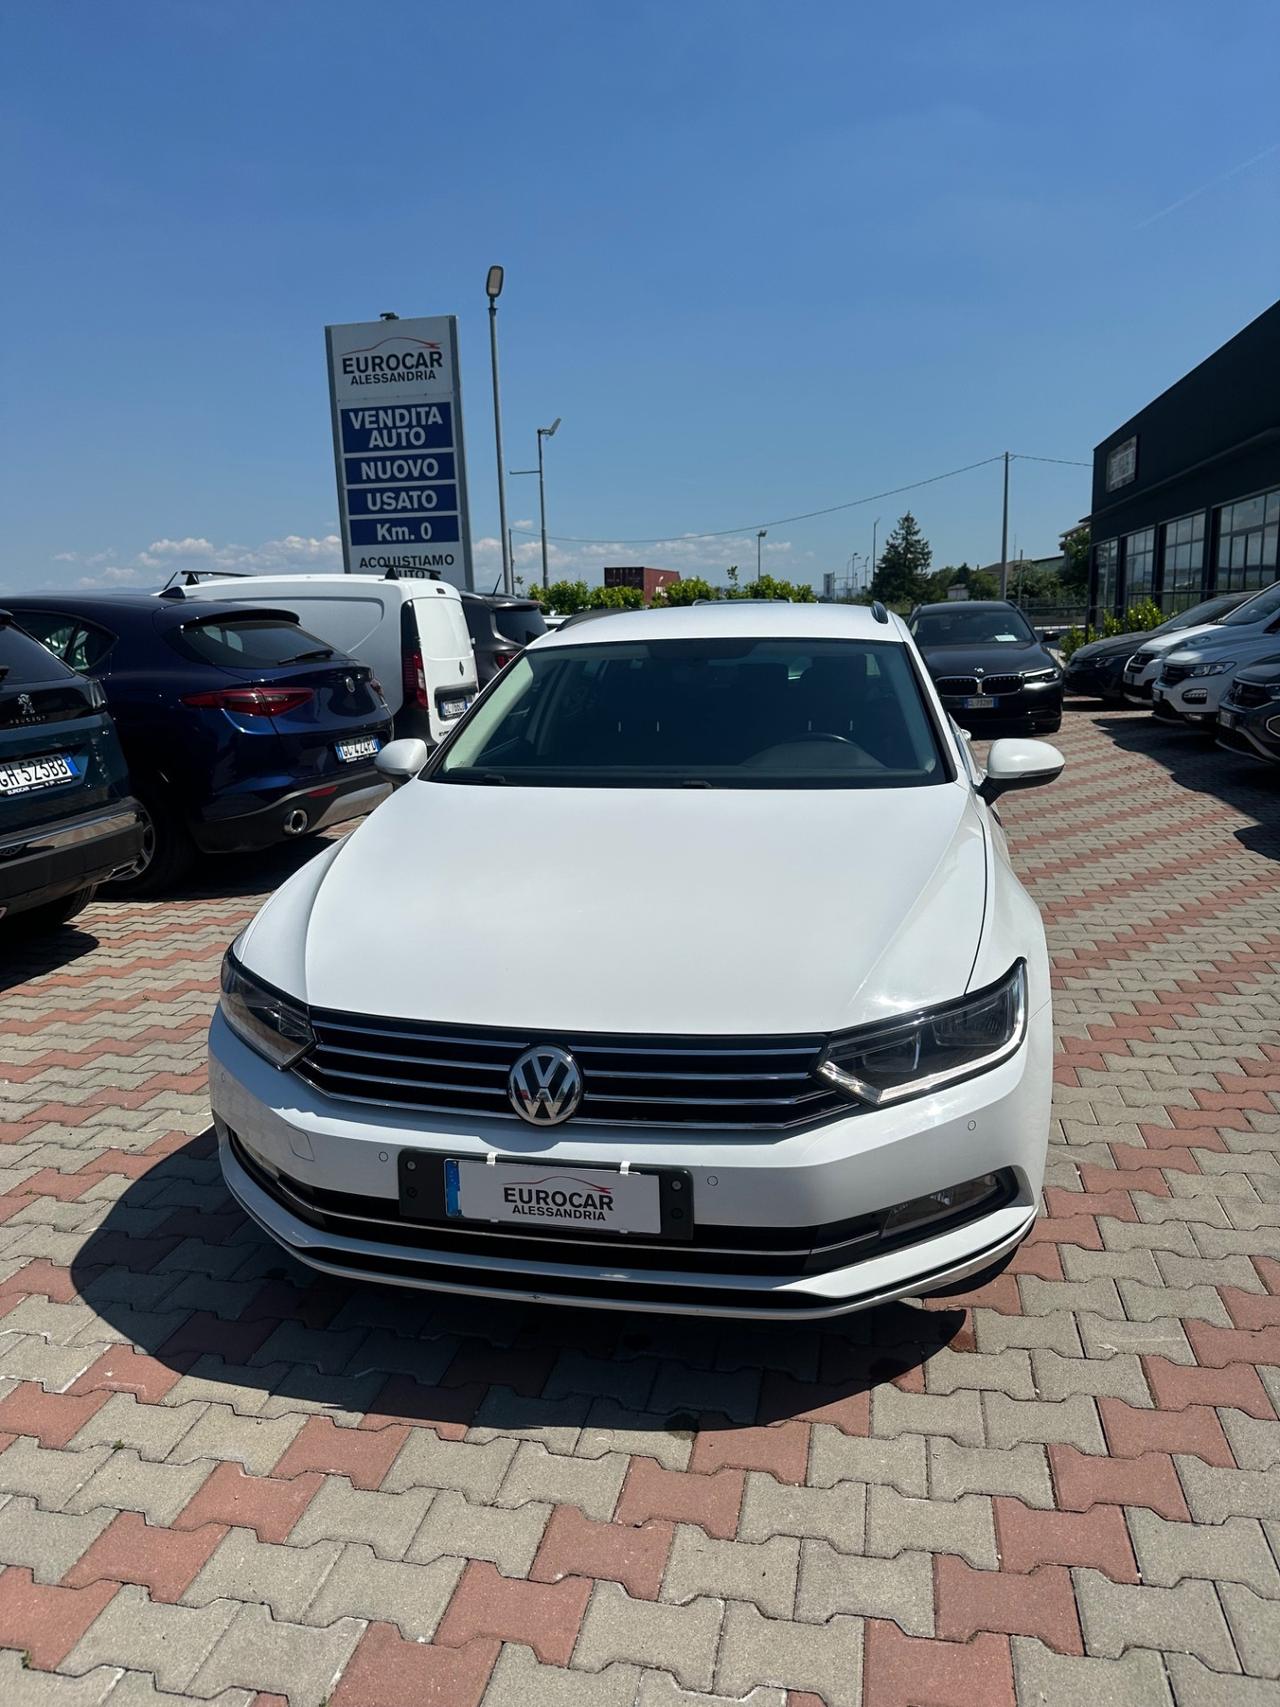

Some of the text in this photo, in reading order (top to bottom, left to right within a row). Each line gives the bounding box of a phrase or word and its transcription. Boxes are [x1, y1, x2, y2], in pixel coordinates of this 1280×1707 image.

[342, 351, 443, 375] EUROCAR
[350, 370, 437, 386] ALESSANDRIA
[349, 407, 443, 429] VENDITA
[368, 427, 426, 448] AUTO
[361, 458, 439, 480] NUOVO
[366, 490, 438, 511] USATO
[376, 522, 432, 541] Km. 0
[359, 554, 455, 568] ACQUISTIAMO
[503, 1187, 614, 1212] EUROCAR
[512, 1204, 606, 1221] ALESSANDRIA
